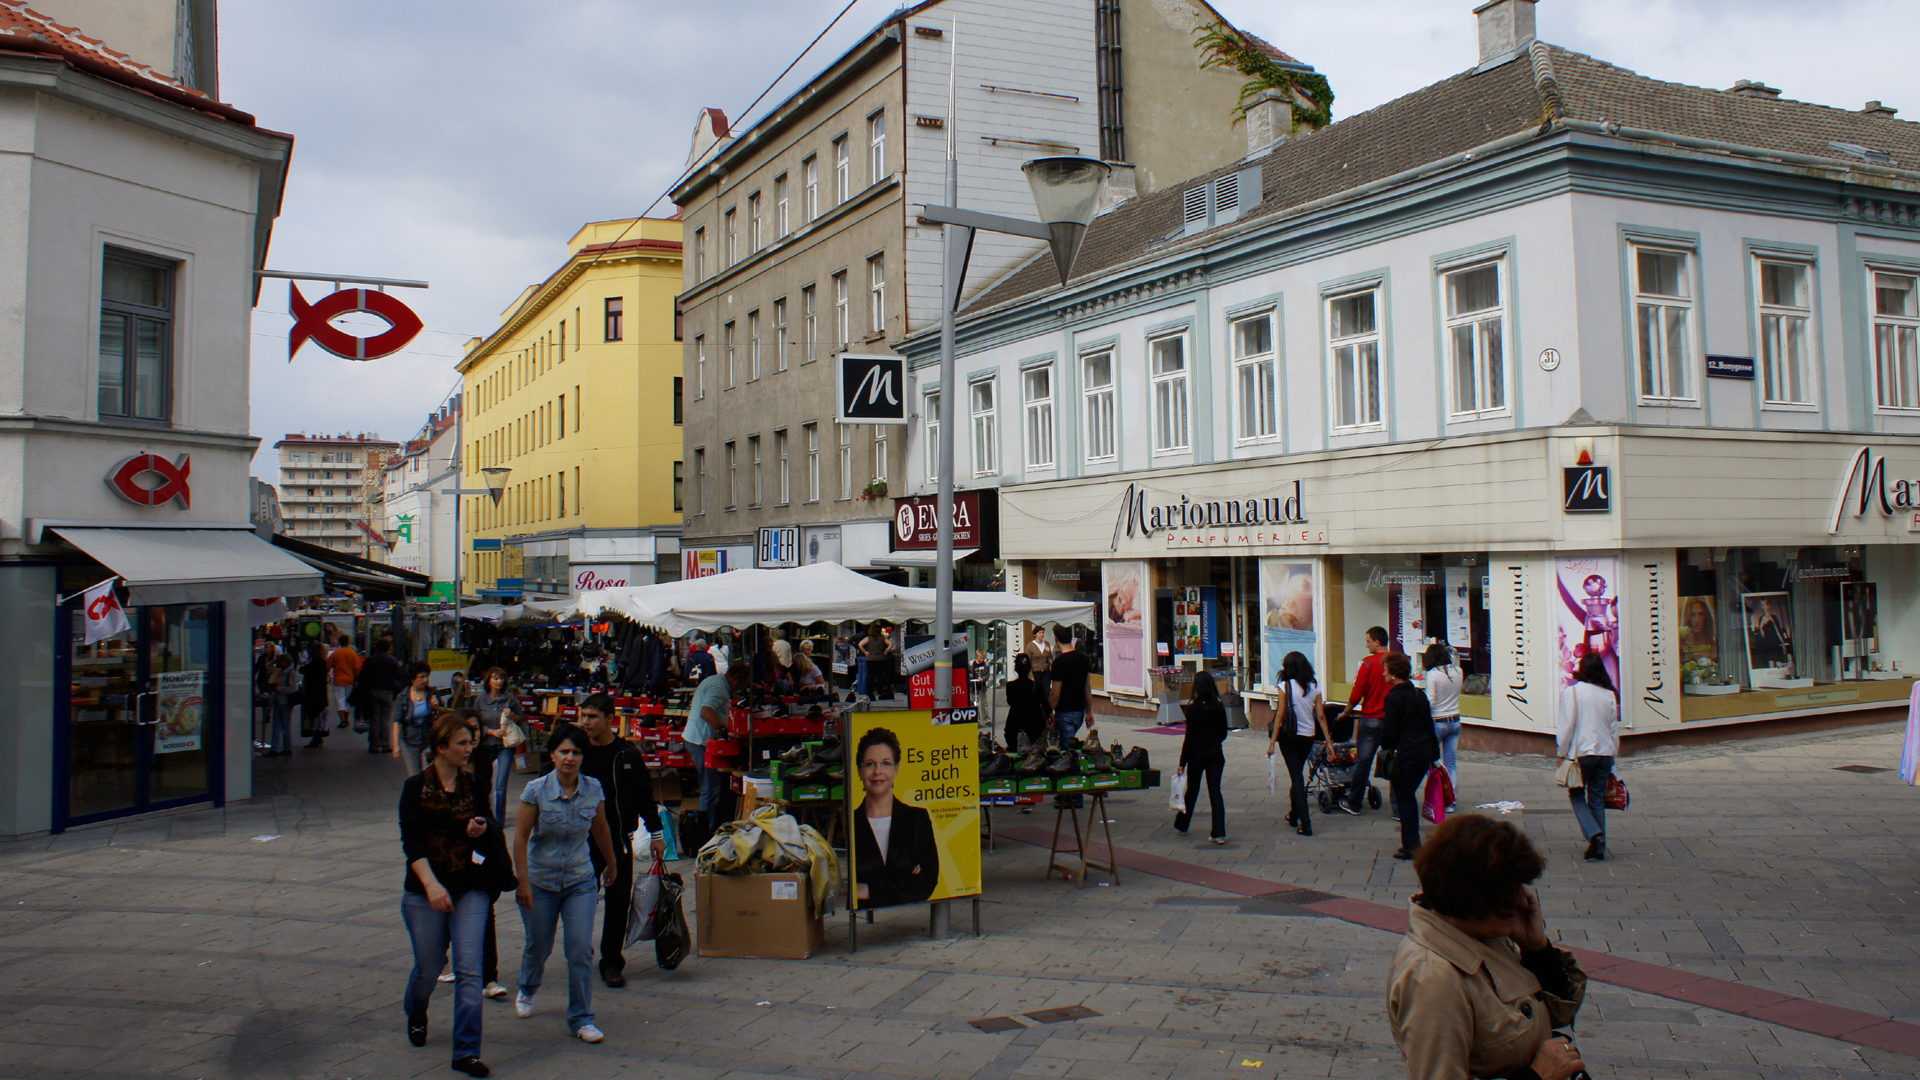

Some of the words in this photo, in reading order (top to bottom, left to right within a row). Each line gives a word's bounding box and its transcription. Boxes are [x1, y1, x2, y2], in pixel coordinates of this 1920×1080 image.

[1544, 351, 1555, 364] 31
[1718, 361, 1753, 372] Bonygasse
[1111, 479, 1308, 552] Marionnaud
[1167, 530, 1324, 545] PARFUMERIES
[575, 570, 629, 591] Rosa
[1506, 566, 1534, 722] Marionnaud
[1643, 563, 1671, 720] Marionnaud
[162, 673, 200, 683] NORDSEE
[912, 674, 931, 686] Gut
[913, 688, 925, 697] zu
[951, 709, 977, 721] ÖVP
[907, 748, 925, 764] Es
[930, 744, 969, 766] geht
[921, 764, 960, 782] auch
[914, 783, 976, 802] anders.
